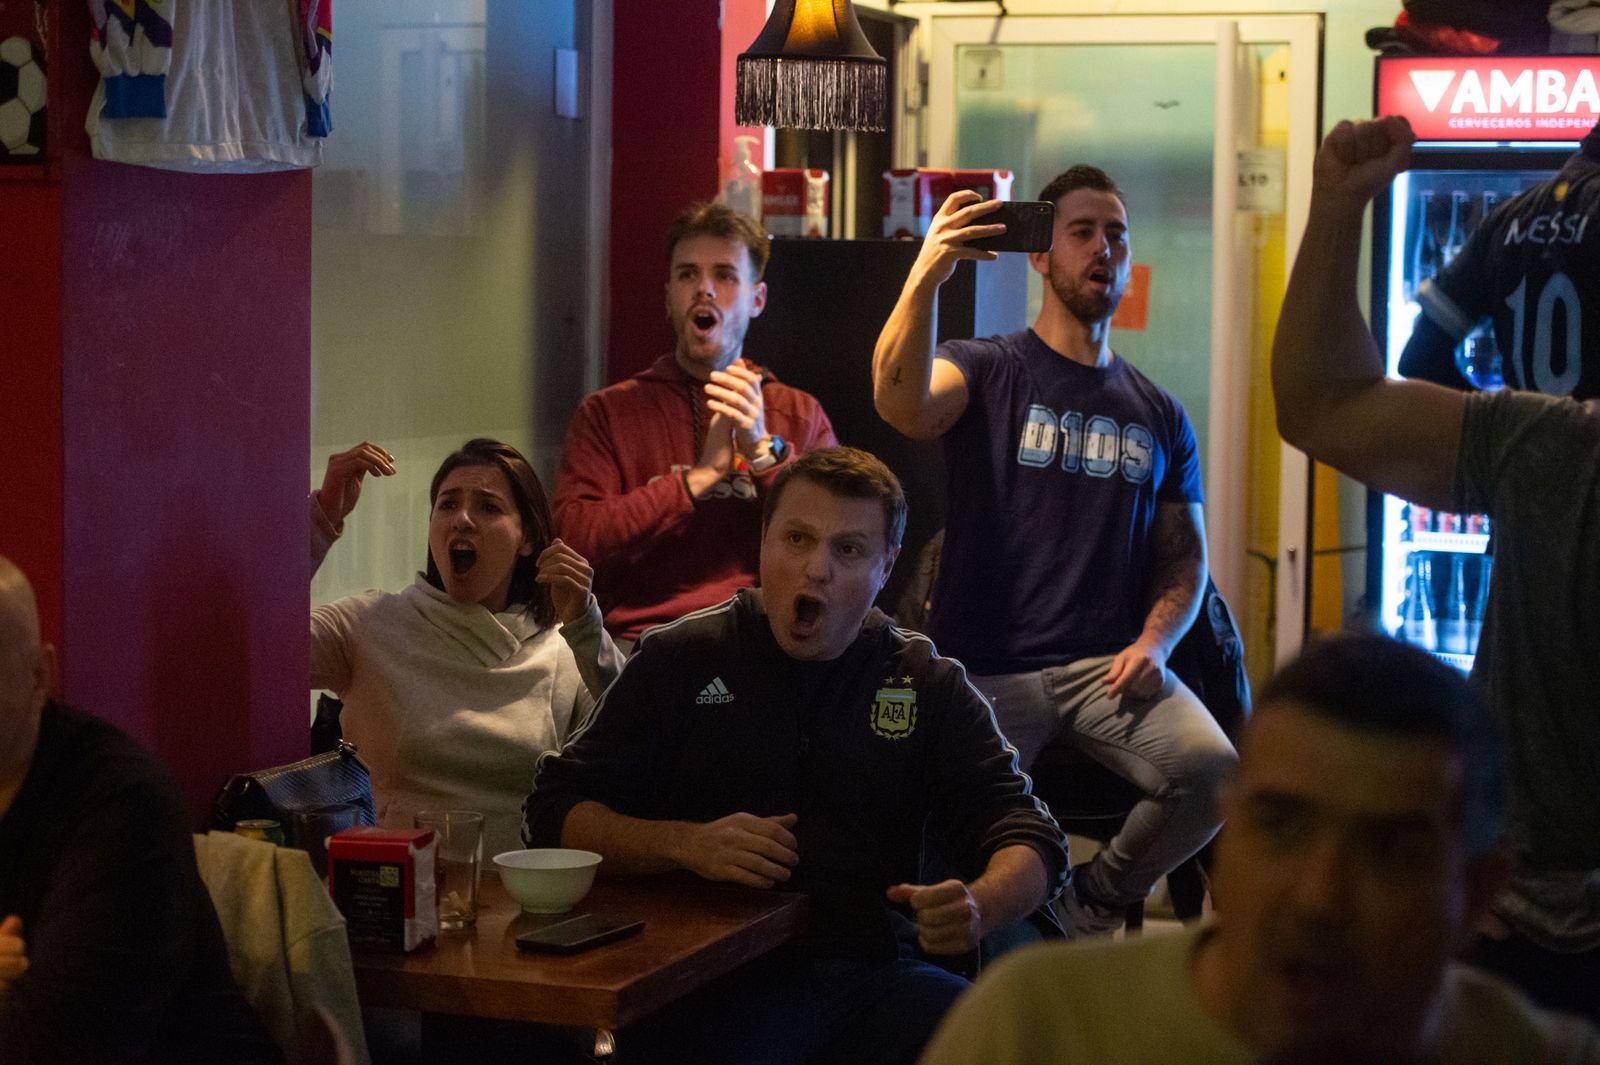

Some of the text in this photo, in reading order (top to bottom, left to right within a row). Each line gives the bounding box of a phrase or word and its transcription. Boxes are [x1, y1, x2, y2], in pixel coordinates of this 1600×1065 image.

[1449, 118, 1531, 129] CERVECEROS
[1505, 272, 1583, 396] 10
[1017, 404, 1154, 485] D10S
[695, 693, 735, 705] adidas
[880, 701, 906, 723] AFA
